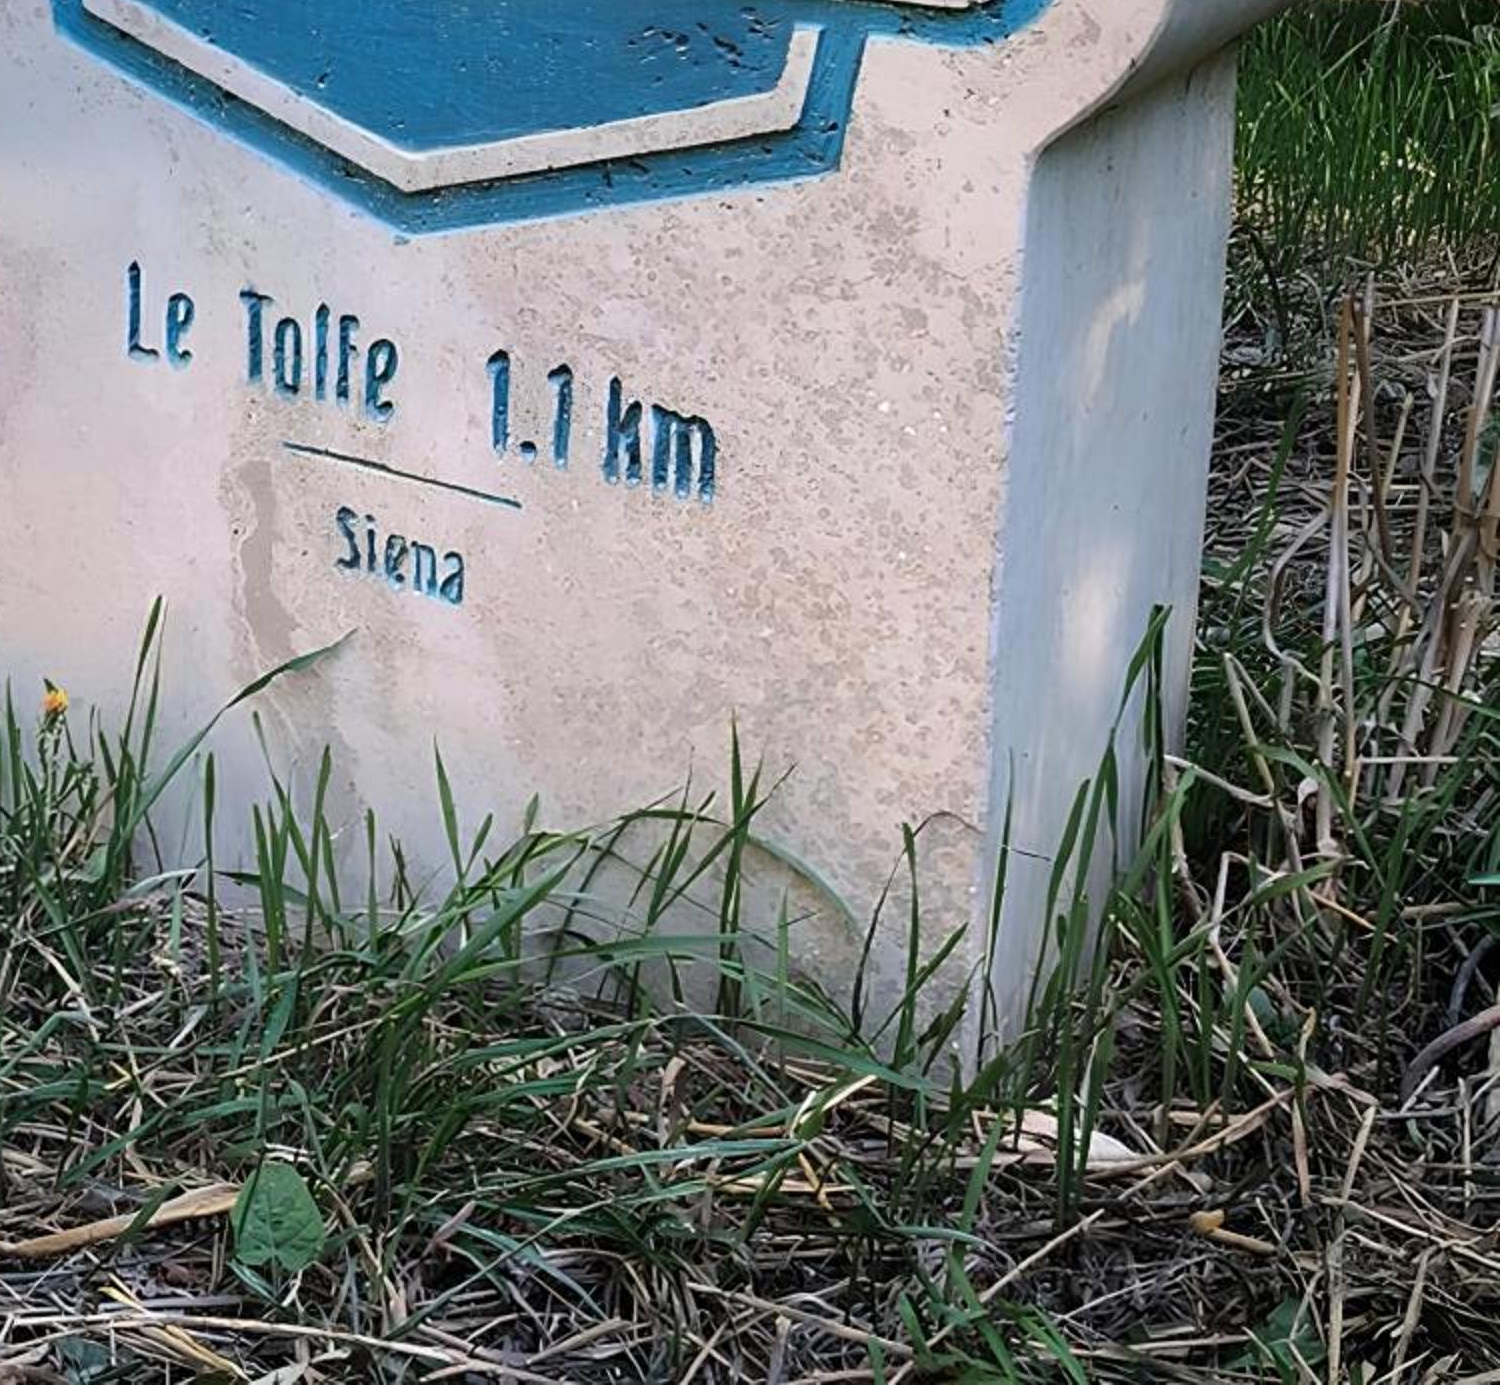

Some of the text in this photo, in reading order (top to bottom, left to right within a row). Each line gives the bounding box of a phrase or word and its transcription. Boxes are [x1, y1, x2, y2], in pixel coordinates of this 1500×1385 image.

[128, 261, 719, 504] Le Tolfe 1.1 km
[336, 506, 467, 605] Siena
